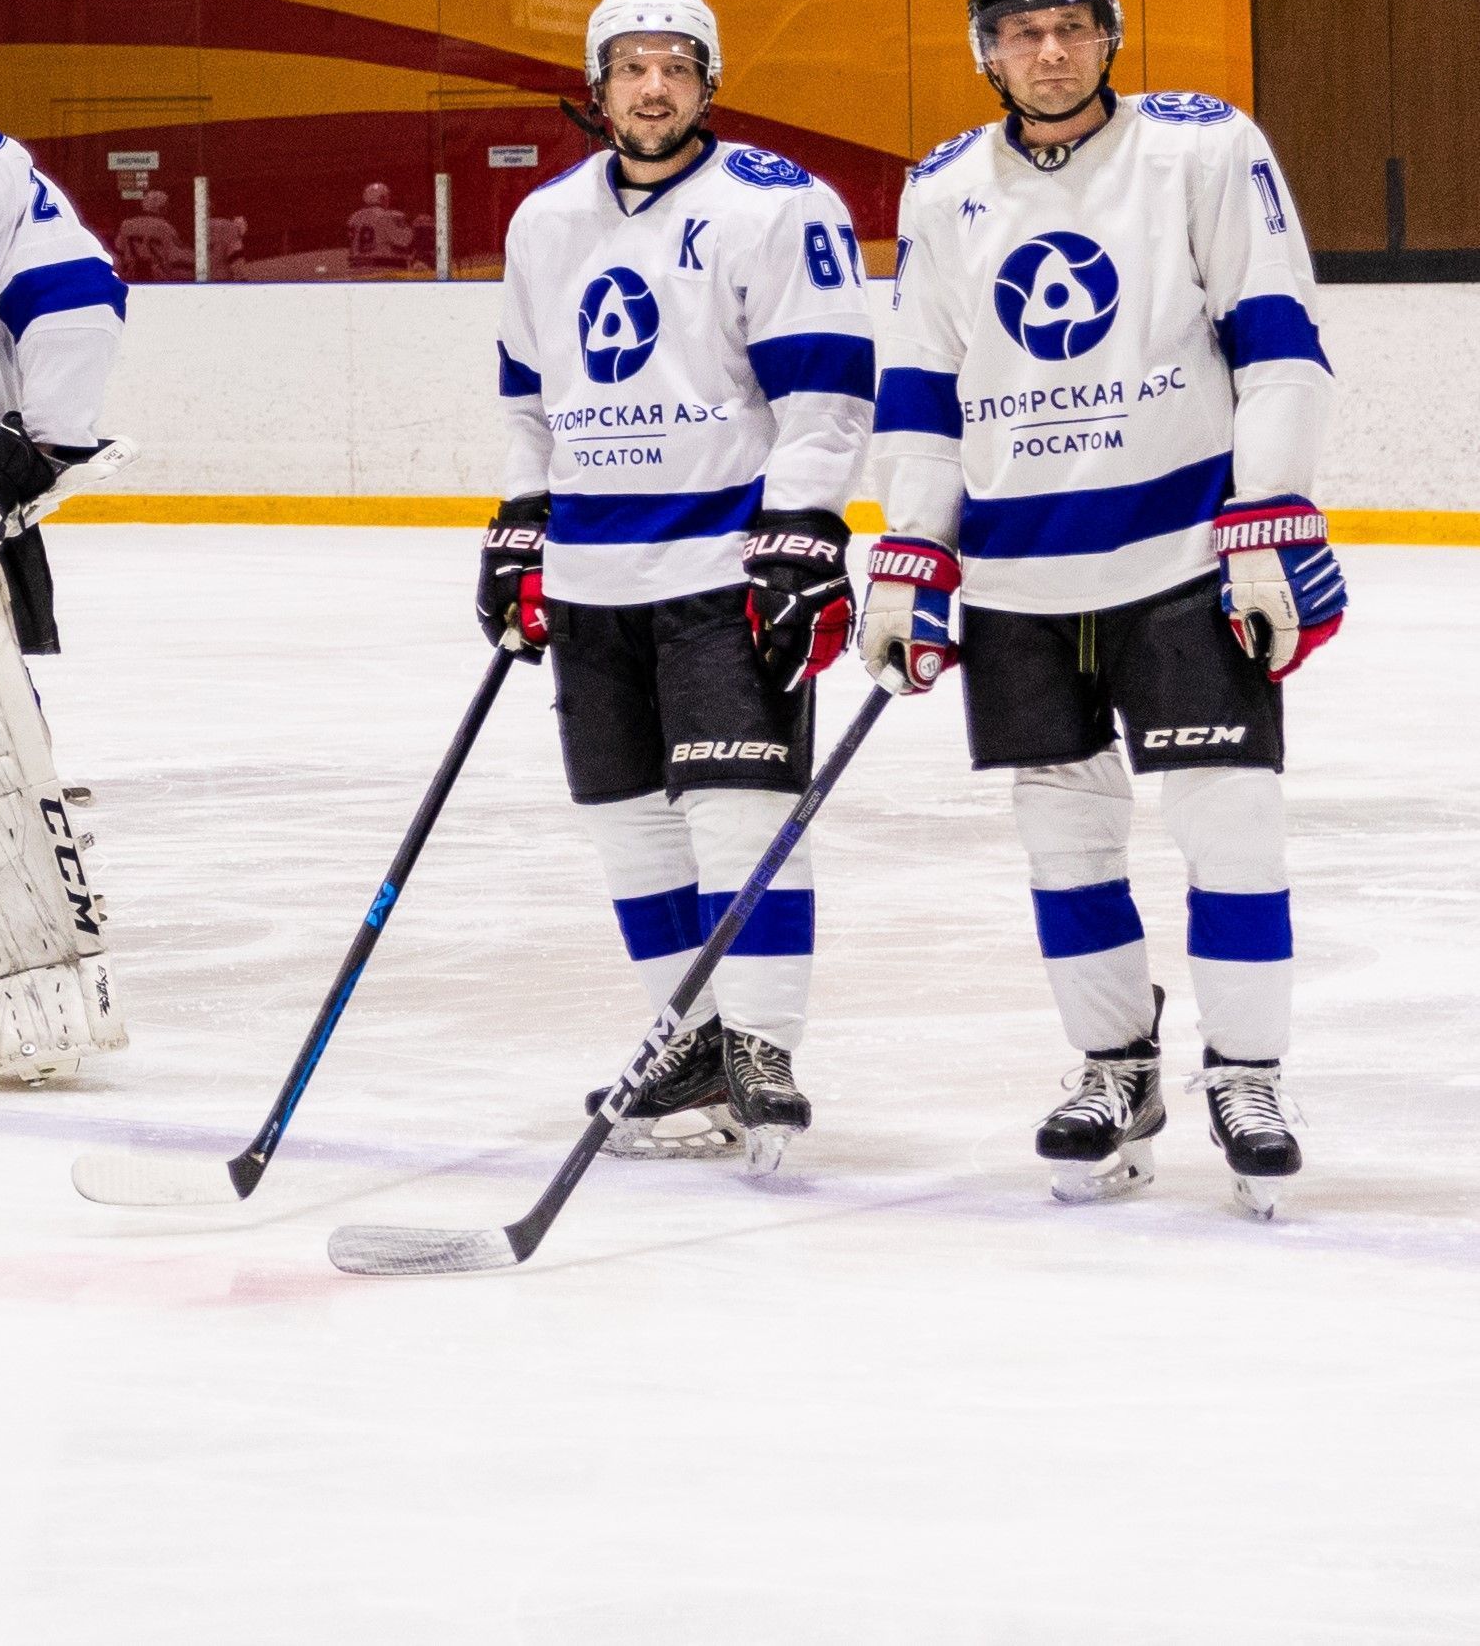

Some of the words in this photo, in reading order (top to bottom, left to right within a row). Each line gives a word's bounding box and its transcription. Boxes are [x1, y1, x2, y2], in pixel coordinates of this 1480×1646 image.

[962, 379, 1124, 424] ЕЛОЯРСКАЯ
[1137, 366, 1187, 400] АЭС
[547, 404, 663, 432] ЕЛОЯРСКАЯ
[674, 403, 729, 424] АЭС
[1012, 429, 1124, 459] РОСАТОМ
[743, 534, 838, 563] AUER
[871, 550, 938, 581] RIOR
[1144, 726, 1246, 748] CCM
[39, 796, 101, 936] CCM
[599, 1003, 684, 1124] CCM
